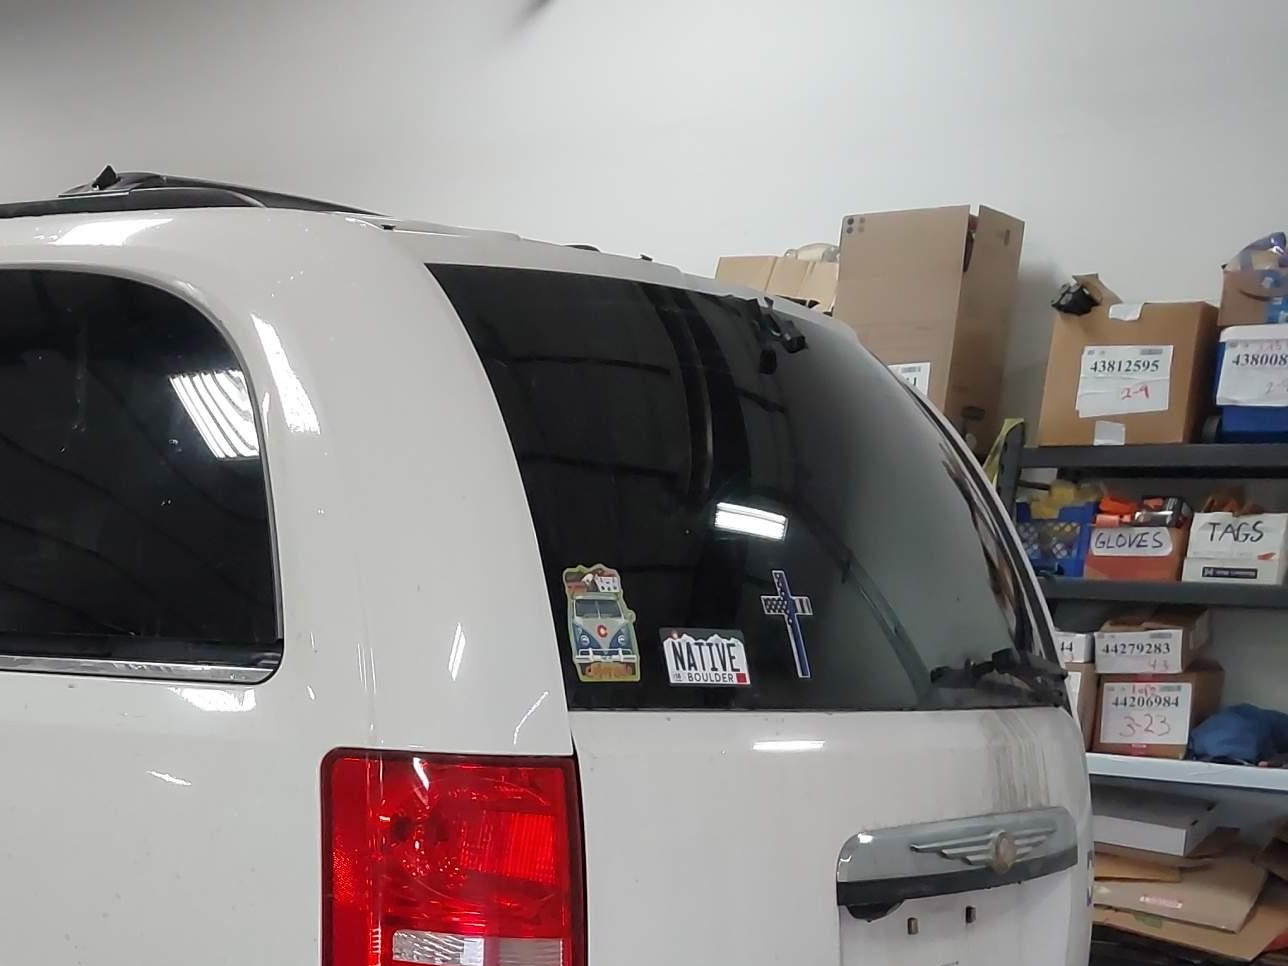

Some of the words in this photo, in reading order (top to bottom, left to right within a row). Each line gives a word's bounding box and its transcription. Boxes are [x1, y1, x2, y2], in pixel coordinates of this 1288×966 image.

[1090, 359, 1160, 373] 43812595
[1208, 521, 1264, 543] TAGS
[1094, 531, 1164, 549] GLOVES
[1102, 643, 1171, 654] 44279283
[672, 641, 741, 673] NATIVE
[688, 672, 734, 683] BOULDER
[1112, 696, 1179, 707] 44206984
